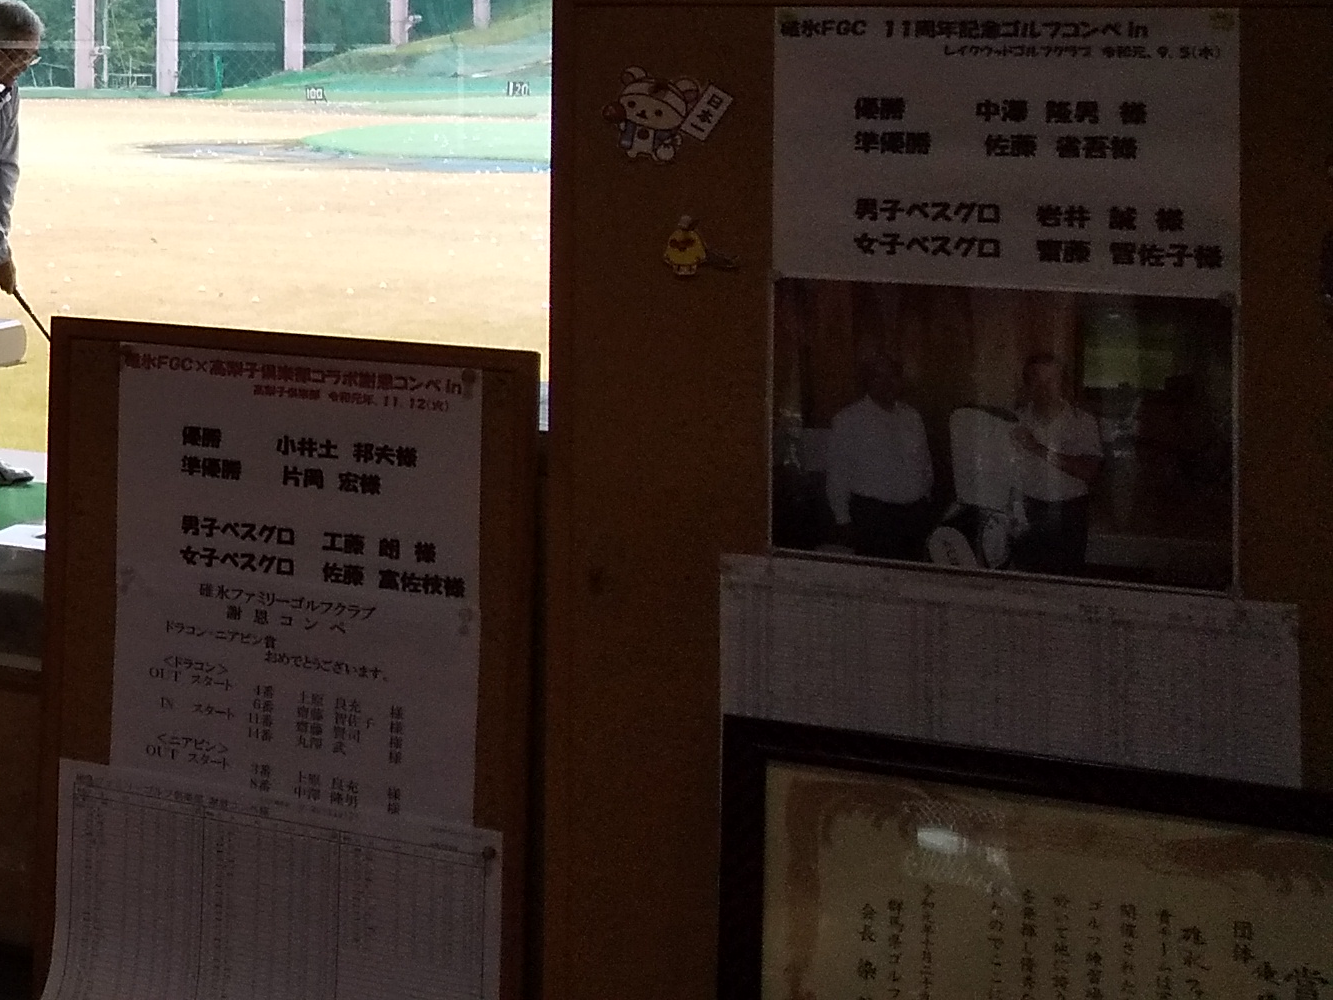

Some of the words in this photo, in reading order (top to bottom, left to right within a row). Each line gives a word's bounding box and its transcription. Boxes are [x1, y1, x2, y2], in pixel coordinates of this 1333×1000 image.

[305, 87, 324, 100] 100
[508, 81, 529, 97] 120
[689, 93, 724, 133] 日本一
[854, 96, 906, 120] 優勝
[854, 131, 931, 155] 準優勝
[984, 133, 1038, 158] 佐藤
[853, 197, 1002, 225] 男子ベスグロ
[1036, 203, 1091, 229] 岩井
[853, 232, 1003, 259] 女子ベスグロ
[182, 426, 222, 449] 優勝
[276, 435, 339, 461] 小井土
[181, 455, 242, 481] 準優勝
[281, 465, 325, 490] 片岡
[181, 514, 296, 546] 男子ベスグロ
[322, 530, 366, 556] 工藤
[180, 545, 295, 576] 女子ベスグロ
[322, 562, 366, 587] 佐藤
[198, 582, 378, 621] 碓氷ファミリーゴルフクラブ
[190, 674, 234, 692] スタート
[192, 703, 235, 721] スタート
[187, 753, 231, 770] スタート
